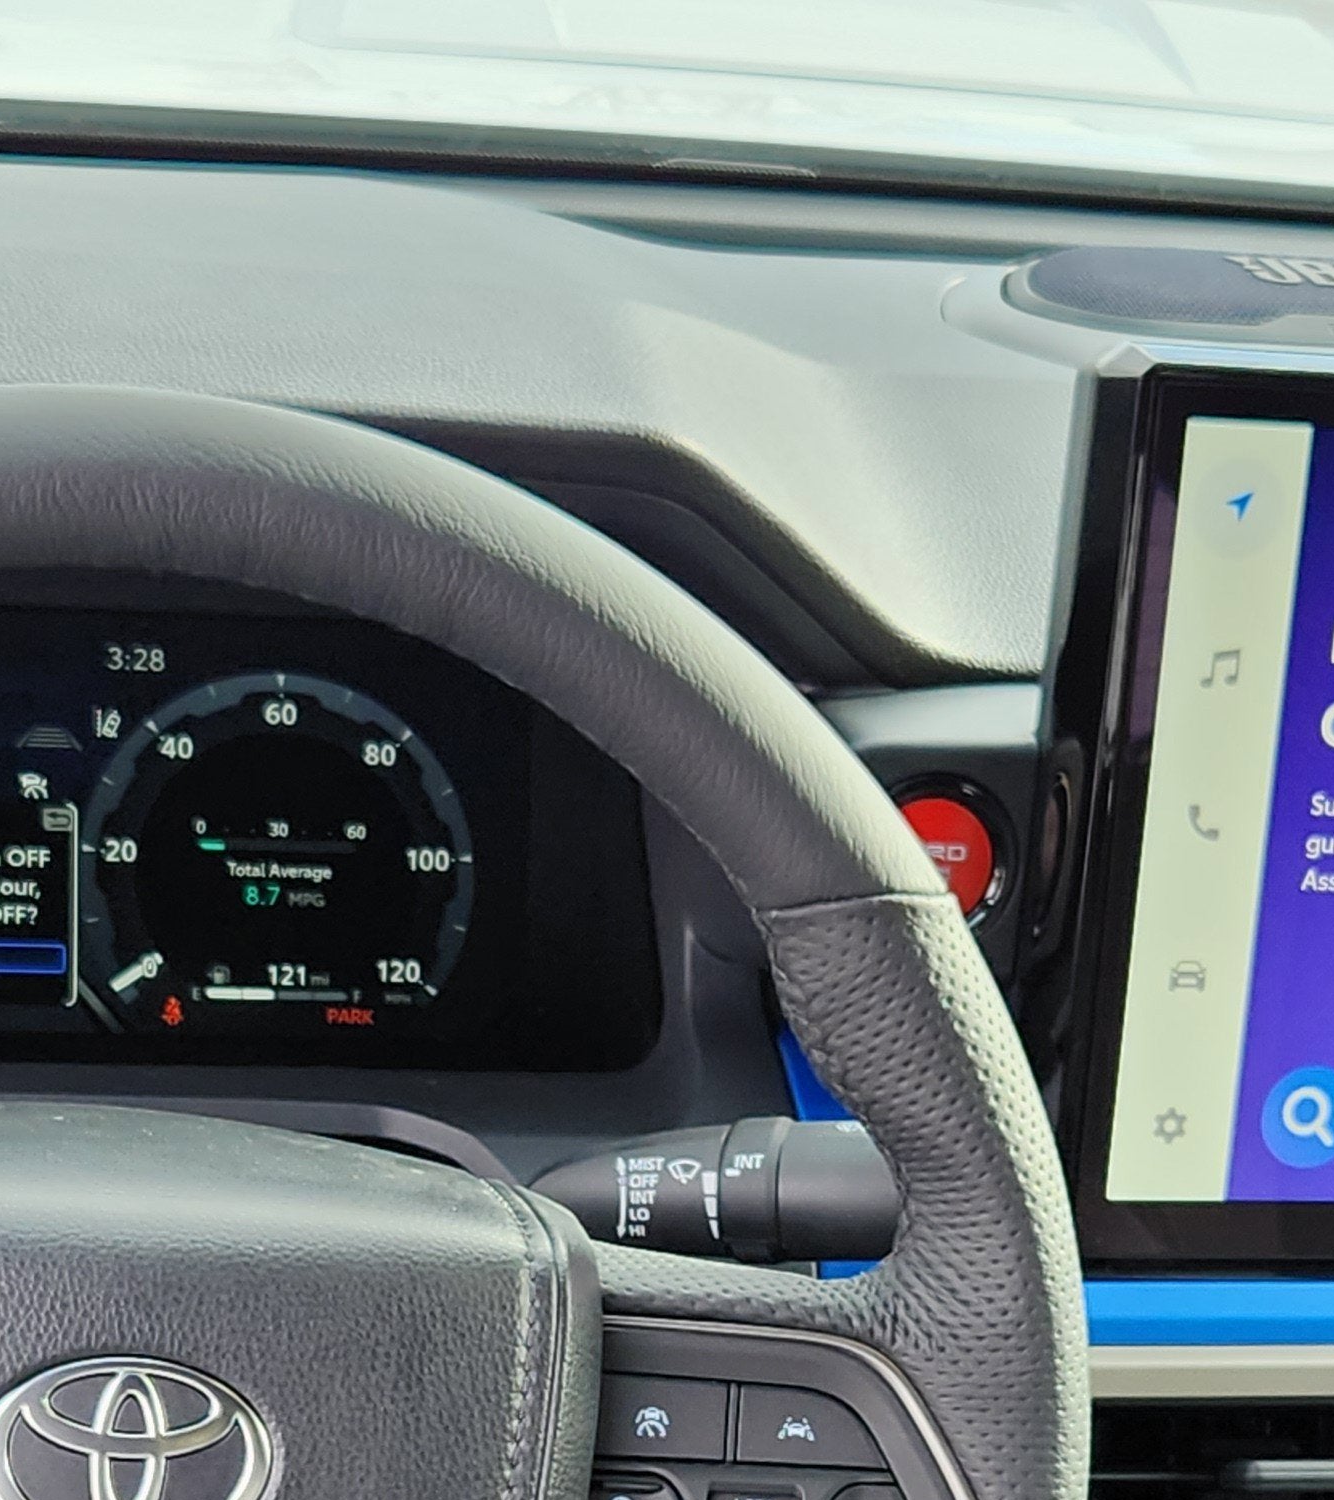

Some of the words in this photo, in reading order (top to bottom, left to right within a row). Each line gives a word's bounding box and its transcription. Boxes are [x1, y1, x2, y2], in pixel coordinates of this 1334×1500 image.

[106, 645, 166, 672] 3:28
[264, 702, 299, 728] 60
[159, 734, 194, 760] 40
[363, 741, 398, 768] 80
[194, 819, 207, 836] 0
[268, 822, 289, 839] 30
[345, 823, 367, 841] 60
[6, 849, 51, 869] OFF
[102, 839, 138, 865] 20
[406, 846, 452, 875] 100
[227, 860, 267, 881] Total
[269, 862, 333, 885] Average
[244, 885, 280, 908] 8.7
[287, 890, 327, 909] MPG
[267, 964, 308, 987] 121
[309, 972, 331, 987] mi
[376, 958, 423, 985] 120
[191, 986, 202, 1002] E
[326, 1009, 375, 1026] PARK
[628, 1157, 665, 1172] MIST
[733, 1153, 765, 1170] INT
[629, 1174, 659, 1189] OFF
[629, 1189, 657, 1205] INT
[628, 1207, 651, 1222] LO
[629, 1223, 646, 1238] HI
